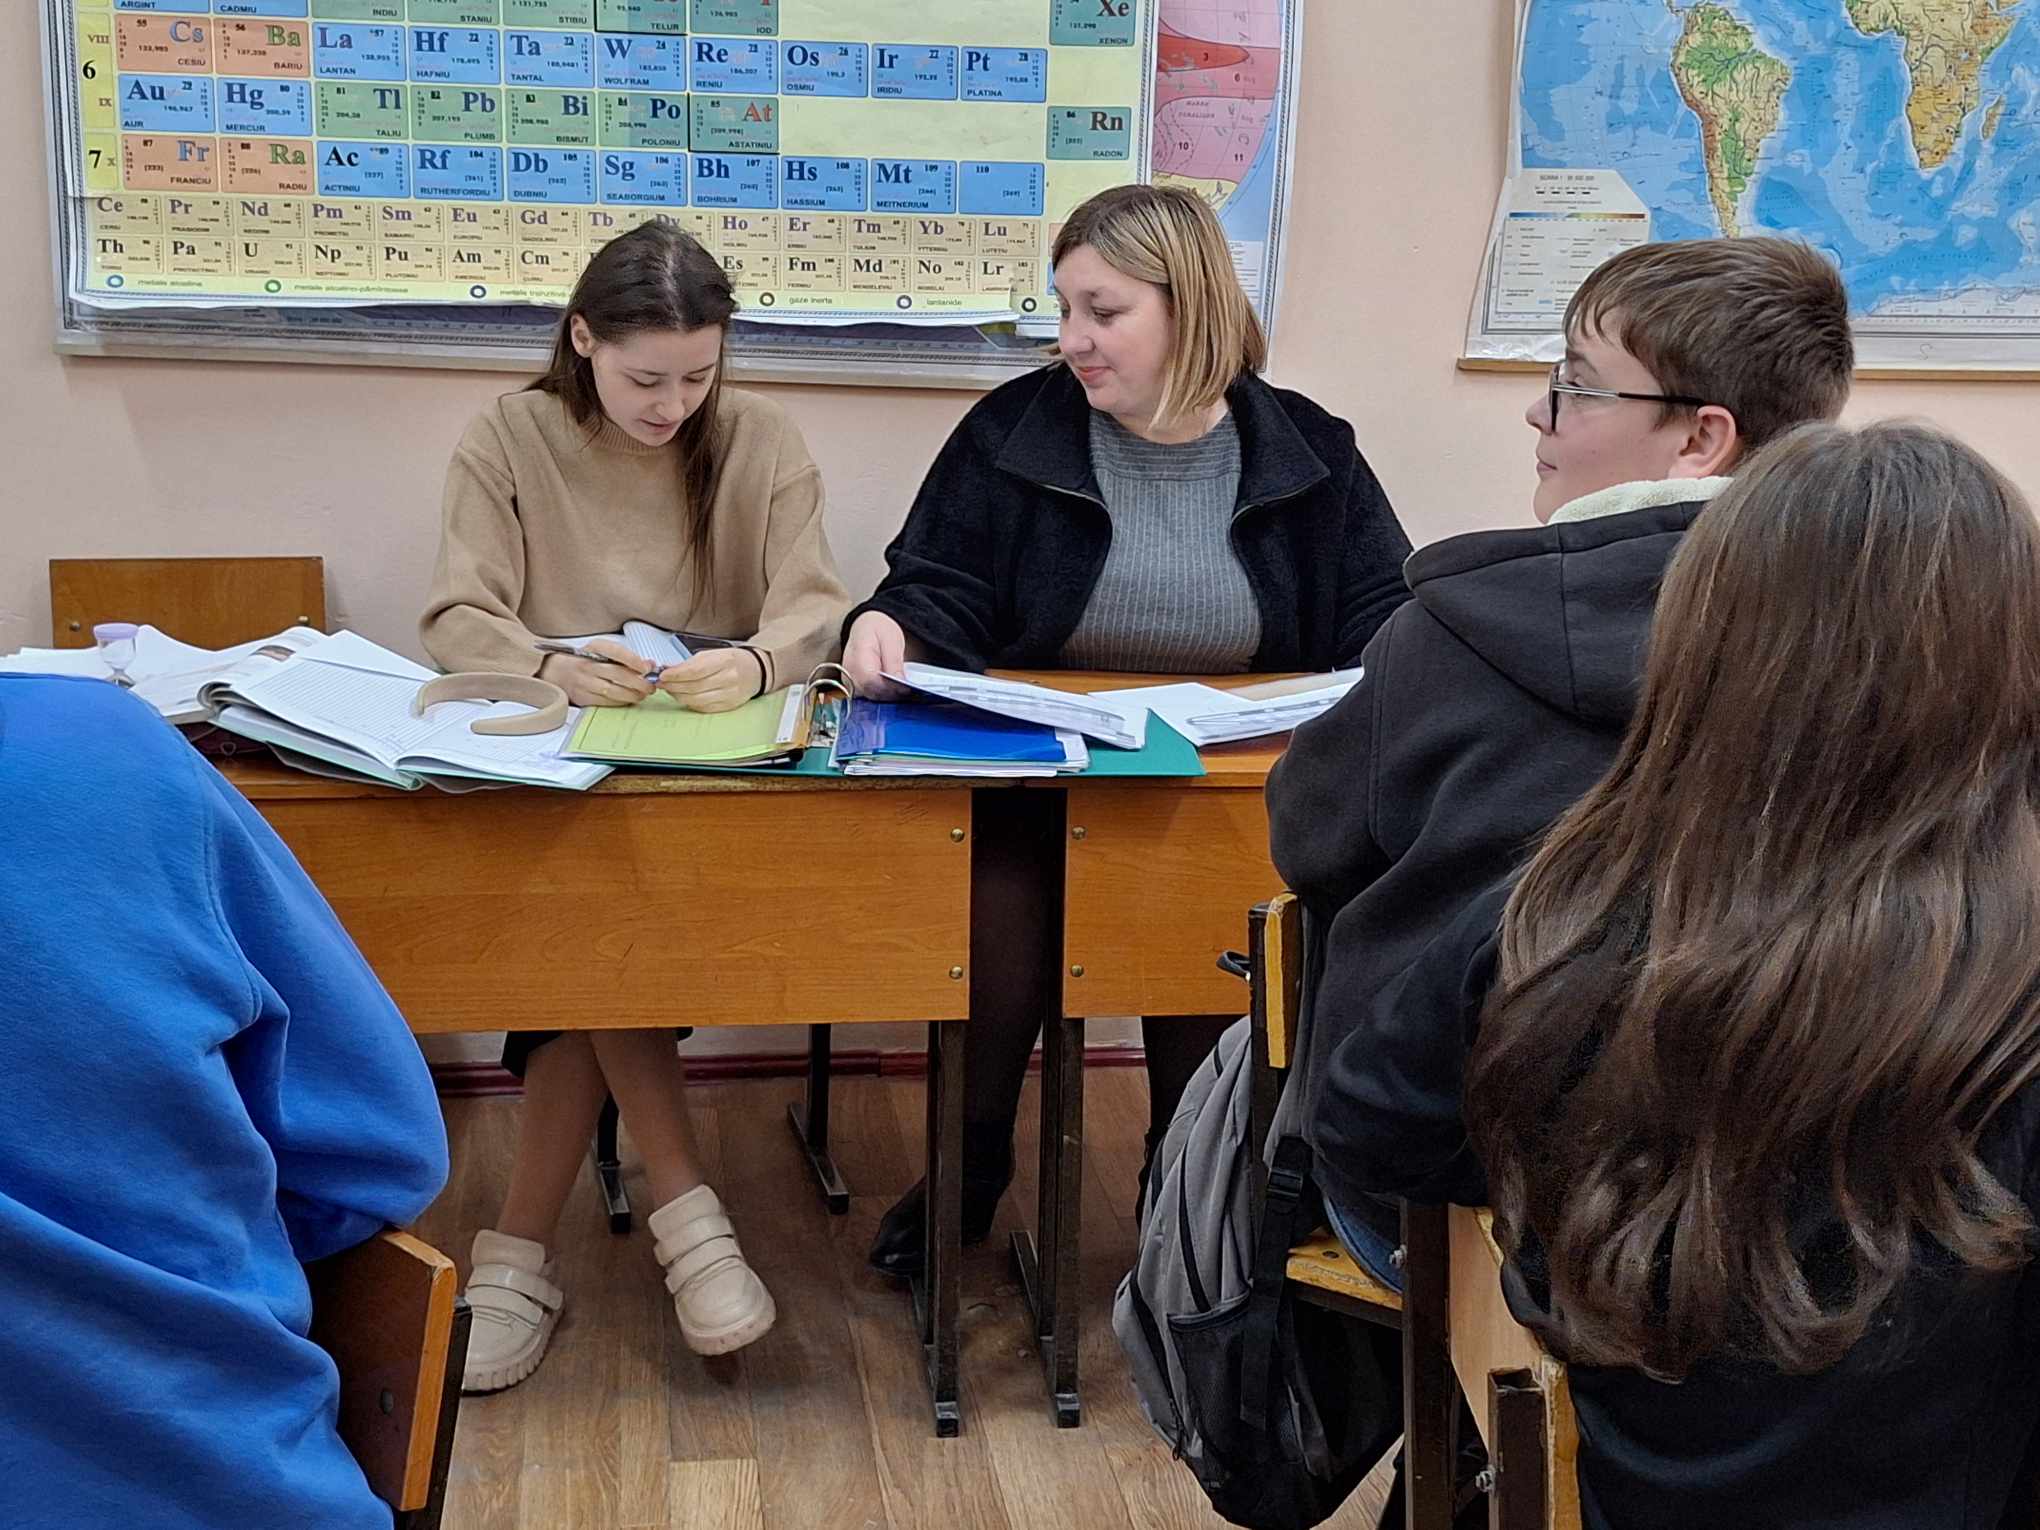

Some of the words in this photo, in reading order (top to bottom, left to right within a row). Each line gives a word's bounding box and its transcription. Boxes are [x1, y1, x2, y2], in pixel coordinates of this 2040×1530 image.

[120, 0, 157, 9] ARGINT
[220, 4, 257, 14] CADMIU
[1096, 0, 1131, 17] Xe
[372, 9, 398, 17] INDIU
[460, 15, 493, 24] STANIU
[559, 16, 588, 25] STIBIU
[170, 20, 204, 43] Cs
[651, 23, 679, 31] TELUR
[756, 26, 773, 34] IOD
[87, 34, 111, 45] VIII
[265, 25, 301, 48] Ba
[318, 26, 353, 49] La
[413, 30, 450, 53] Hf
[1099, 37, 1130, 45] XENON
[510, 35, 542, 57] Ta
[604, 38, 633, 60] W
[695, 42, 729, 64] Re
[177, 58, 207, 67] CESIU
[787, 45, 820, 67] Os
[877, 48, 899, 69] Ir
[966, 51, 991, 72] Pt
[82, 59, 97, 80] 6
[273, 62, 304, 71] BARIU
[319, 67, 356, 75] LANTAN
[416, 70, 450, 78] HAFNIU
[511, 74, 545, 82] TANTAL
[604, 76, 650, 86] WOLFRAM
[696, 80, 723, 88] RENIU
[1234, 73, 1241, 82] 6
[127, 79, 166, 101] Au
[786, 83, 815, 92] OSMIU
[877, 86, 903, 95] IRIDIU
[967, 89, 1003, 98] PLATINA
[99, 97, 112, 108] IX
[224, 82, 265, 110] Hg
[373, 88, 402, 110] Tl
[461, 91, 496, 113] Pb
[561, 95, 589, 116] Bi
[649, 98, 681, 120] Po
[742, 101, 773, 123] At
[123, 120, 145, 129] AUR
[225, 123, 266, 132] MERCUR
[1089, 111, 1123, 131] Rn
[376, 129, 402, 137] TALIU
[464, 132, 496, 140] PLUMB
[556, 136, 589, 144] BISMUT
[641, 138, 681, 147] POLONIU
[728, 141, 773, 149] ASTATINIU
[1178, 142, 1189, 150] 10
[176, 139, 210, 162] Fr
[268, 143, 306, 165] Ra
[324, 146, 360, 167] Ac
[1093, 150, 1123, 158] RADON
[1234, 153, 1244, 162] 11
[88, 149, 102, 169] 7
[417, 148, 451, 170] Rf
[511, 152, 549, 174] Db
[604, 155, 636, 181] Sg
[696, 158, 730, 179] Bh
[785, 160, 818, 182] Hs
[876, 163, 913, 184] Mt
[170, 176, 212, 185] FRANCIU
[278, 182, 308, 191] RADIU
[324, 184, 361, 193] ACTINIU
[513, 190, 548, 199] DUBNIU
[97, 197, 124, 213] Ce
[169, 199, 193, 214] Pr
[240, 201, 269, 216] Nd
[786, 198, 826, 206] HASSIUM
[876, 200, 929, 209] MEITNERIUM
[312, 203, 343, 219] Pm
[382, 206, 412, 221] Sm
[452, 208, 477, 223] Eu
[521, 210, 548, 225] Gd
[588, 211, 613, 227] Tb
[722, 216, 748, 230] Ho
[788, 217, 811, 231] Er
[853, 219, 881, 234] Tm
[919, 221, 944, 235] Yb
[983, 222, 1007, 237] Lu
[96, 238, 124, 254] Th
[172, 241, 196, 256] Pa
[243, 243, 259, 257] U
[314, 244, 342, 263] Np
[384, 247, 409, 261] Pu
[453, 248, 481, 263] Am
[521, 250, 550, 265] Cm
[723, 256, 743, 270] Es
[788, 257, 816, 272] Fm
[853, 258, 882, 273] Md
[917, 260, 942, 274] No
[982, 261, 1005, 276] Lr
